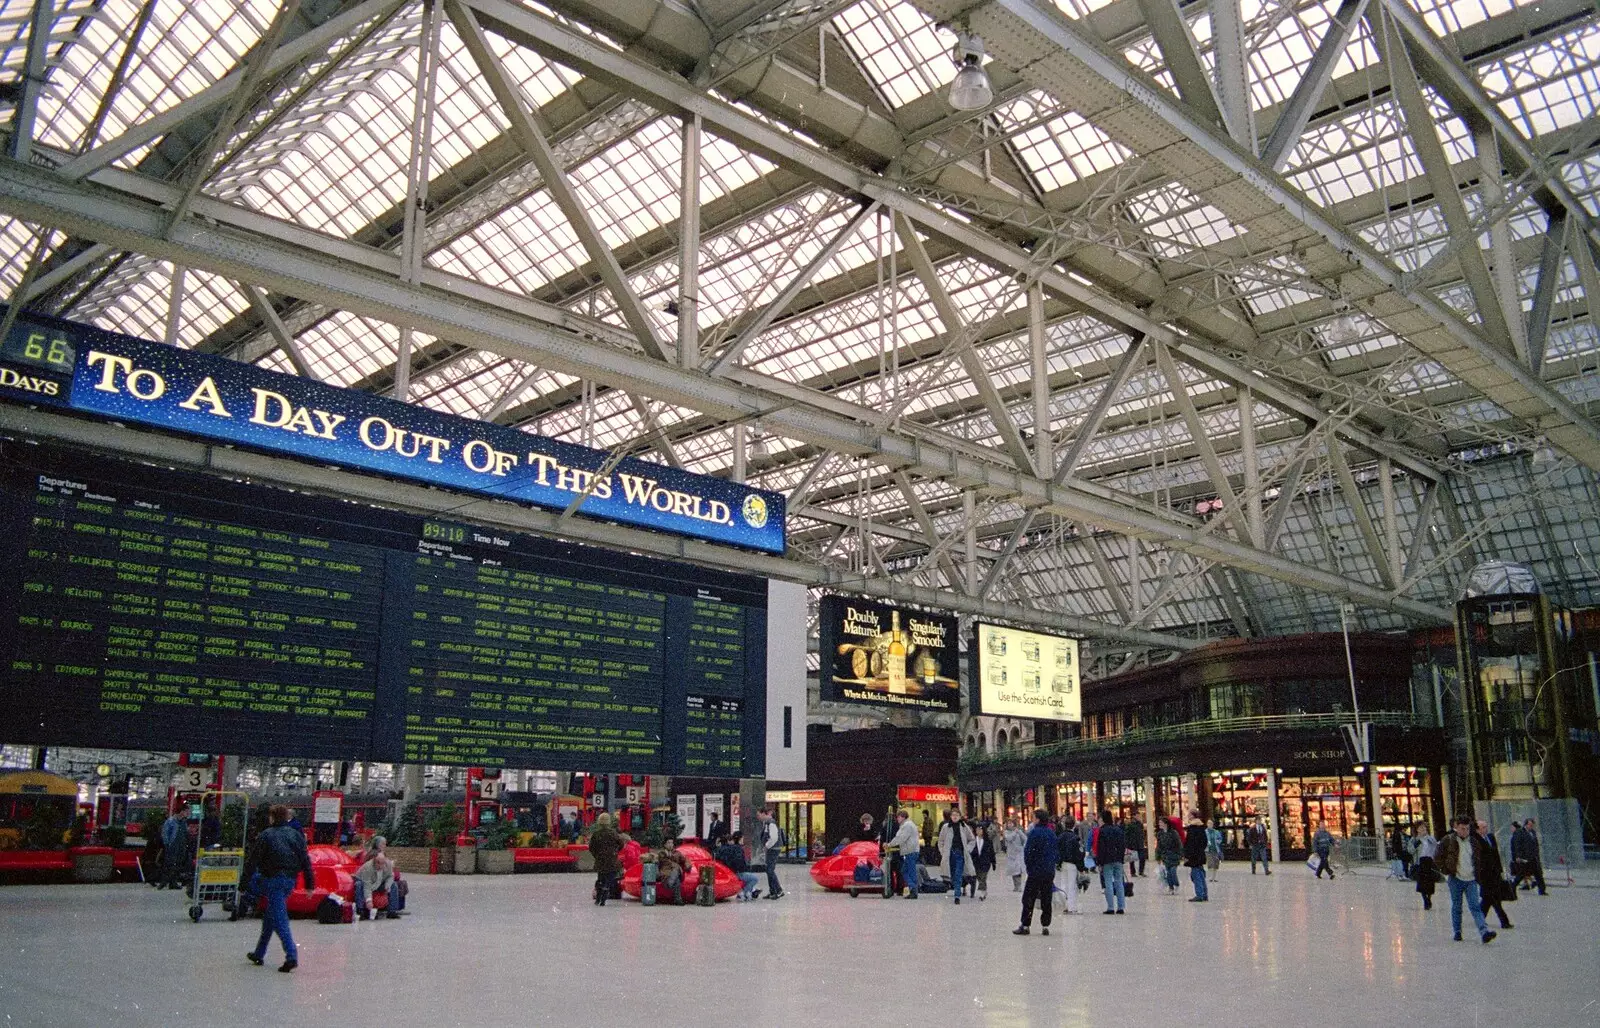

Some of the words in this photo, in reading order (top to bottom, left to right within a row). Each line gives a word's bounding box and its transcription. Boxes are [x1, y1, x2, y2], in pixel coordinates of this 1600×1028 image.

[24, 334, 66, 363] 66
[179, 376, 232, 417] A
[39, 475, 87, 490] Departures
[424, 523, 464, 542] 09:10
[419, 540, 452, 552] Departures
[474, 534, 491, 544] Time
[493, 537, 510, 547] Now
[847, 607, 879, 627] Doubly
[844, 619, 882, 638] Matured.
[909, 618, 947, 638] Singularly
[912, 632, 946, 648] Smooth.
[887, 694, 904, 704] Taking
[998, 691, 1010, 702] Use
[1012, 692, 1021, 703] the
[1023, 694, 1046, 706] Scottish
[1047, 697, 1065, 708] Card.
[1294, 751, 1318, 759] SOCK
[1321, 750, 1345, 758] SHOP
[189, 772, 201, 786] 3
[484, 783, 493, 795] 4
[629, 790, 636, 801] 5
[595, 796, 602, 804] 6
